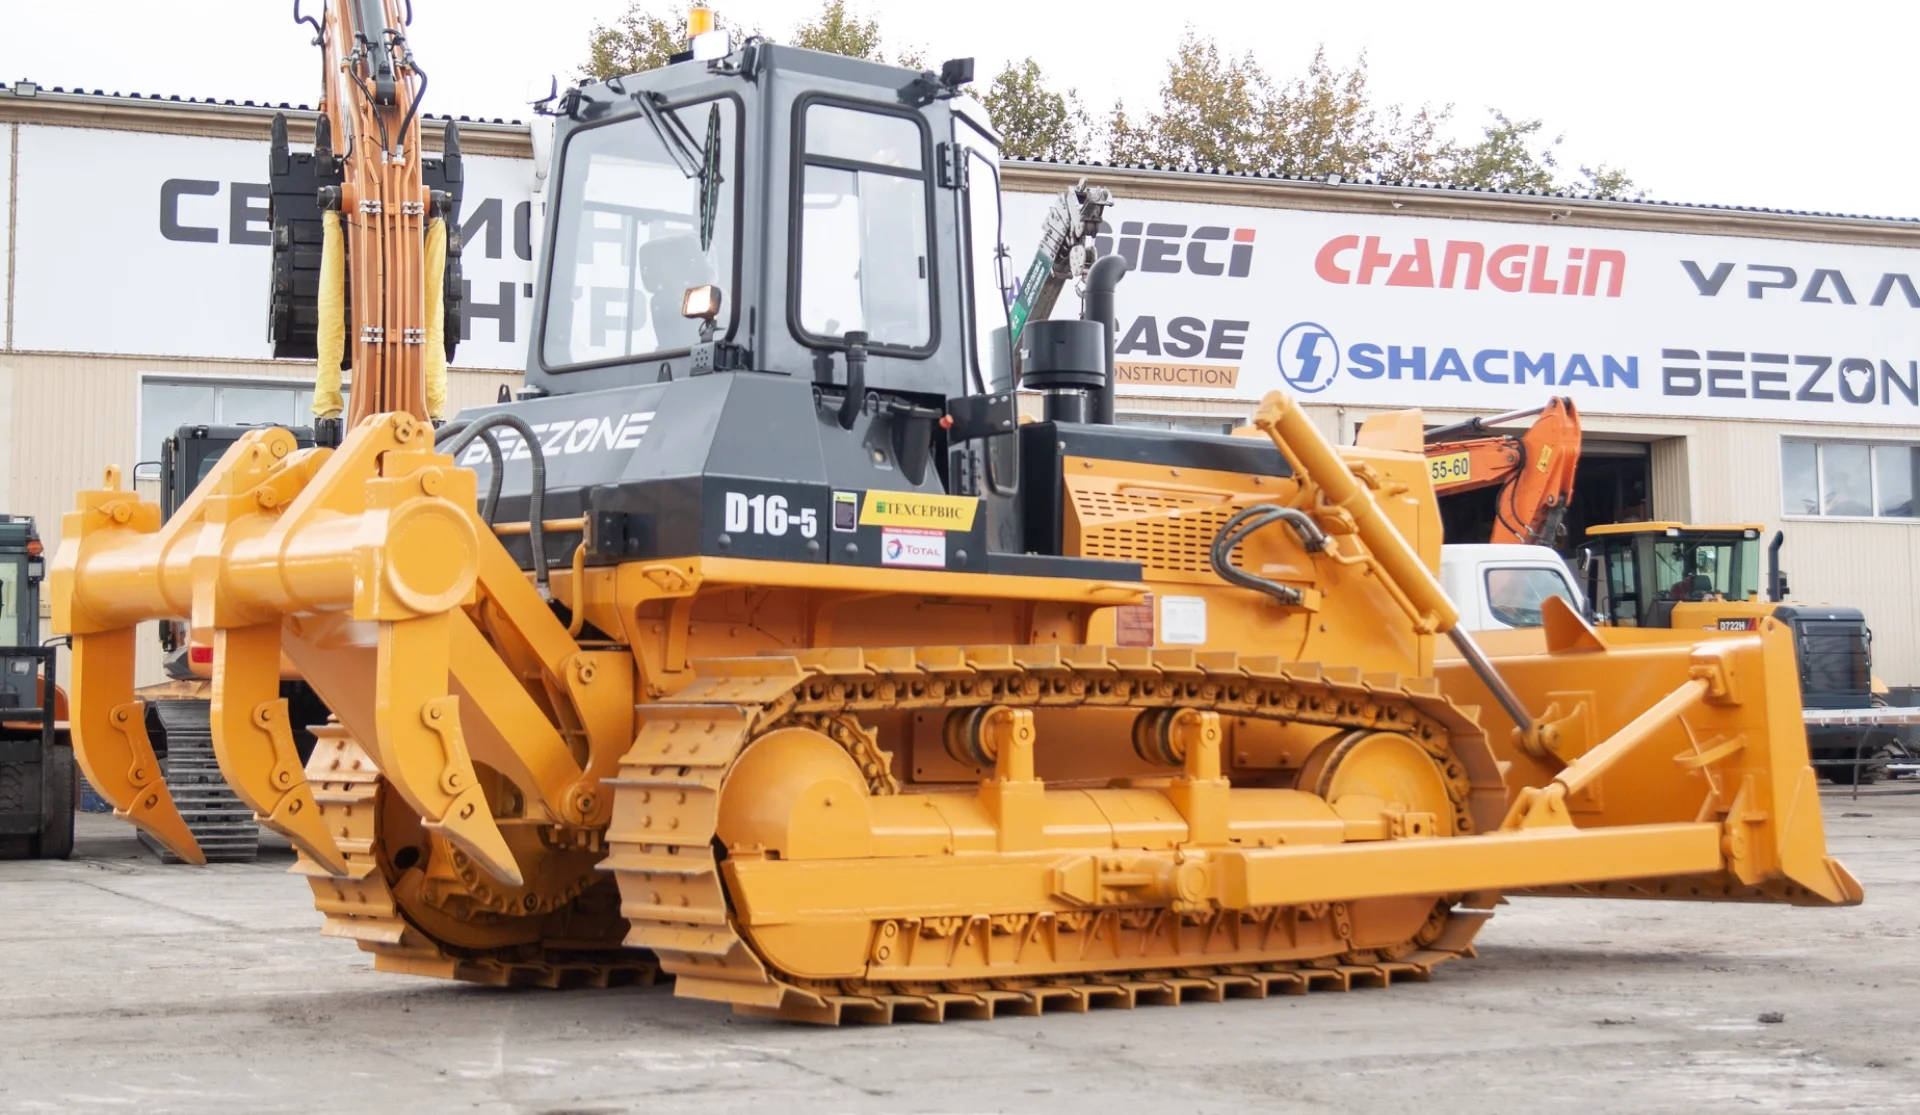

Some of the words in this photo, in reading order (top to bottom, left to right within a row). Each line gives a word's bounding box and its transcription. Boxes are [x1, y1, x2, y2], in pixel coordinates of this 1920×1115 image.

[1114, 315, 1250, 360] ASE
[1115, 366, 1232, 384] NSTRUCTION
[1347, 342, 1640, 389] SHACMAN
[460, 411, 656, 466] BEEZONE
[724, 492, 818, 538] D16-5
[888, 503, 964, 519] ТЕХСЕРВИС
[1719, 621, 1746, 631] D722H
